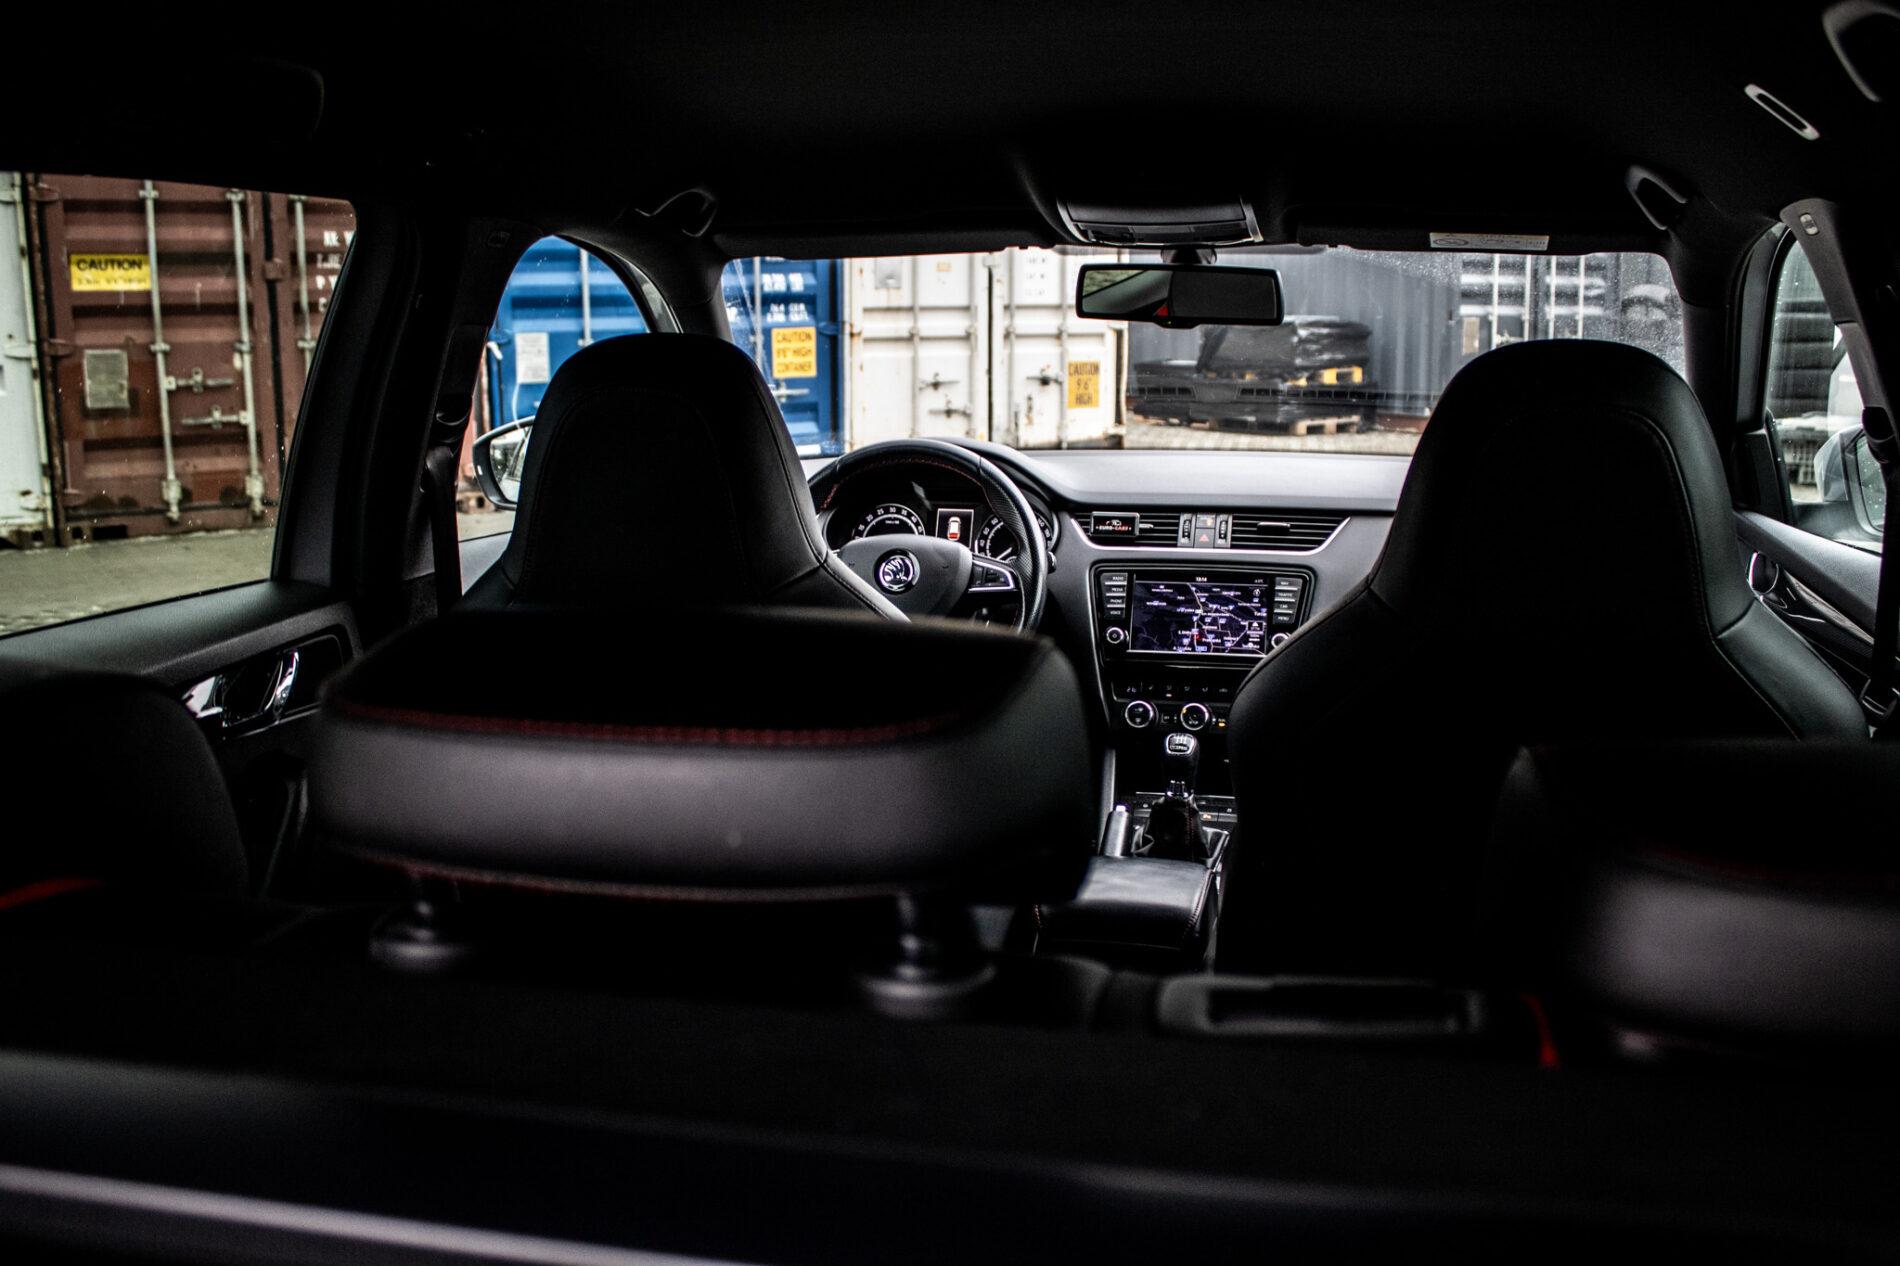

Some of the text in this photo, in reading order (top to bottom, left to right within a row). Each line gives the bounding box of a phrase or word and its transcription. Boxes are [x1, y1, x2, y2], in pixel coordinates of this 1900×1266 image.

[76, 258, 143, 271] CAUTION
[776, 331, 812, 343] CAUTION
[1068, 362, 1098, 376] CAUTION
